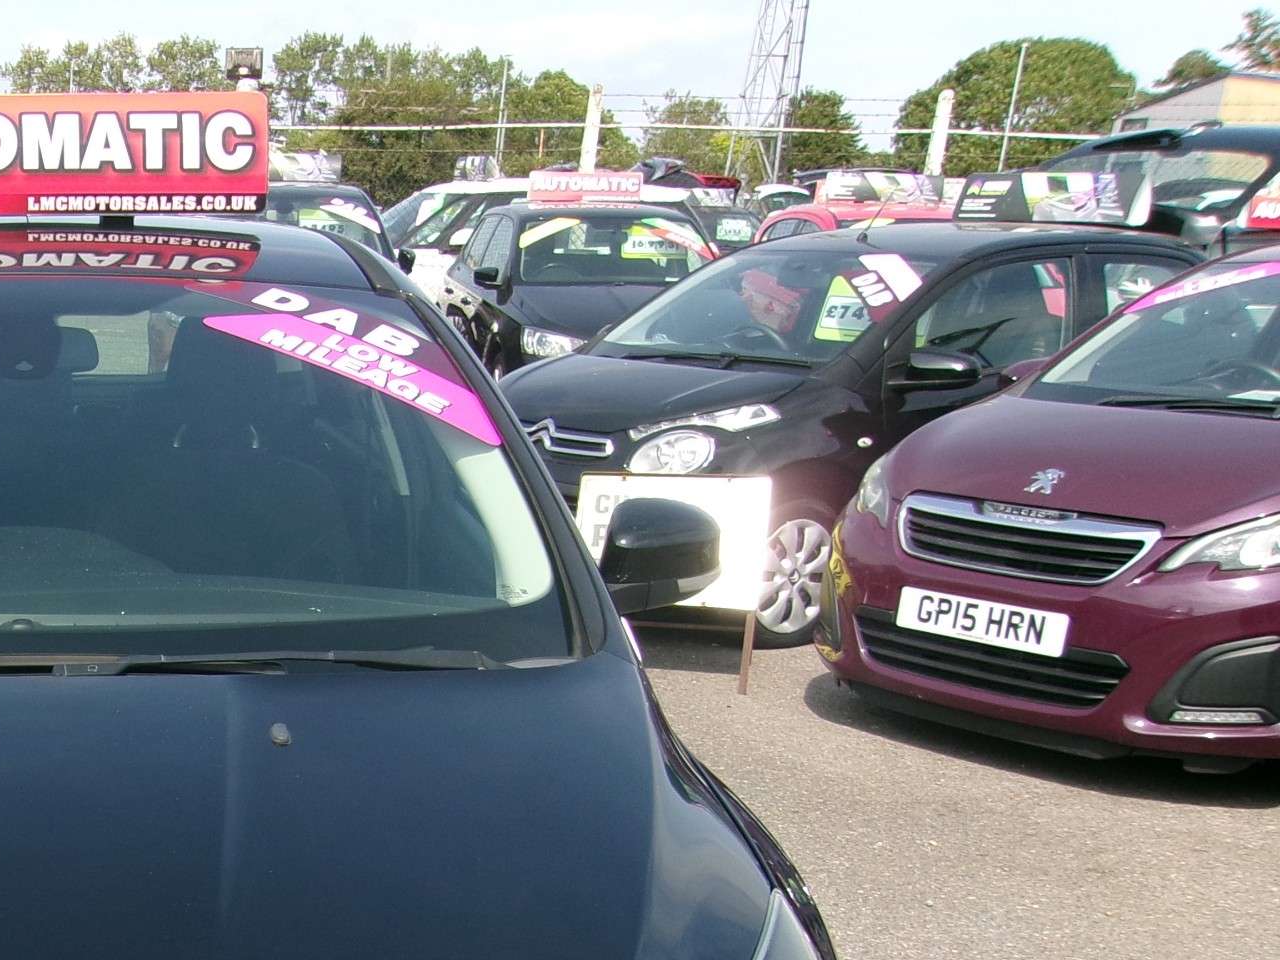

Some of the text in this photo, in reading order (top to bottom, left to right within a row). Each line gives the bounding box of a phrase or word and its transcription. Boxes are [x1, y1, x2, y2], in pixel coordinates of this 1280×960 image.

[27, 196, 258, 212] LMCMOTORSALES.CO.UK
[532, 176, 640, 192] AUTOMATIC
[850, 271, 894, 307] DAB
[251, 287, 420, 356] DAB
[259, 328, 452, 415] MILEAGE
[322, 334, 420, 377] LOW
[917, 595, 1047, 645] GP15 HRN
